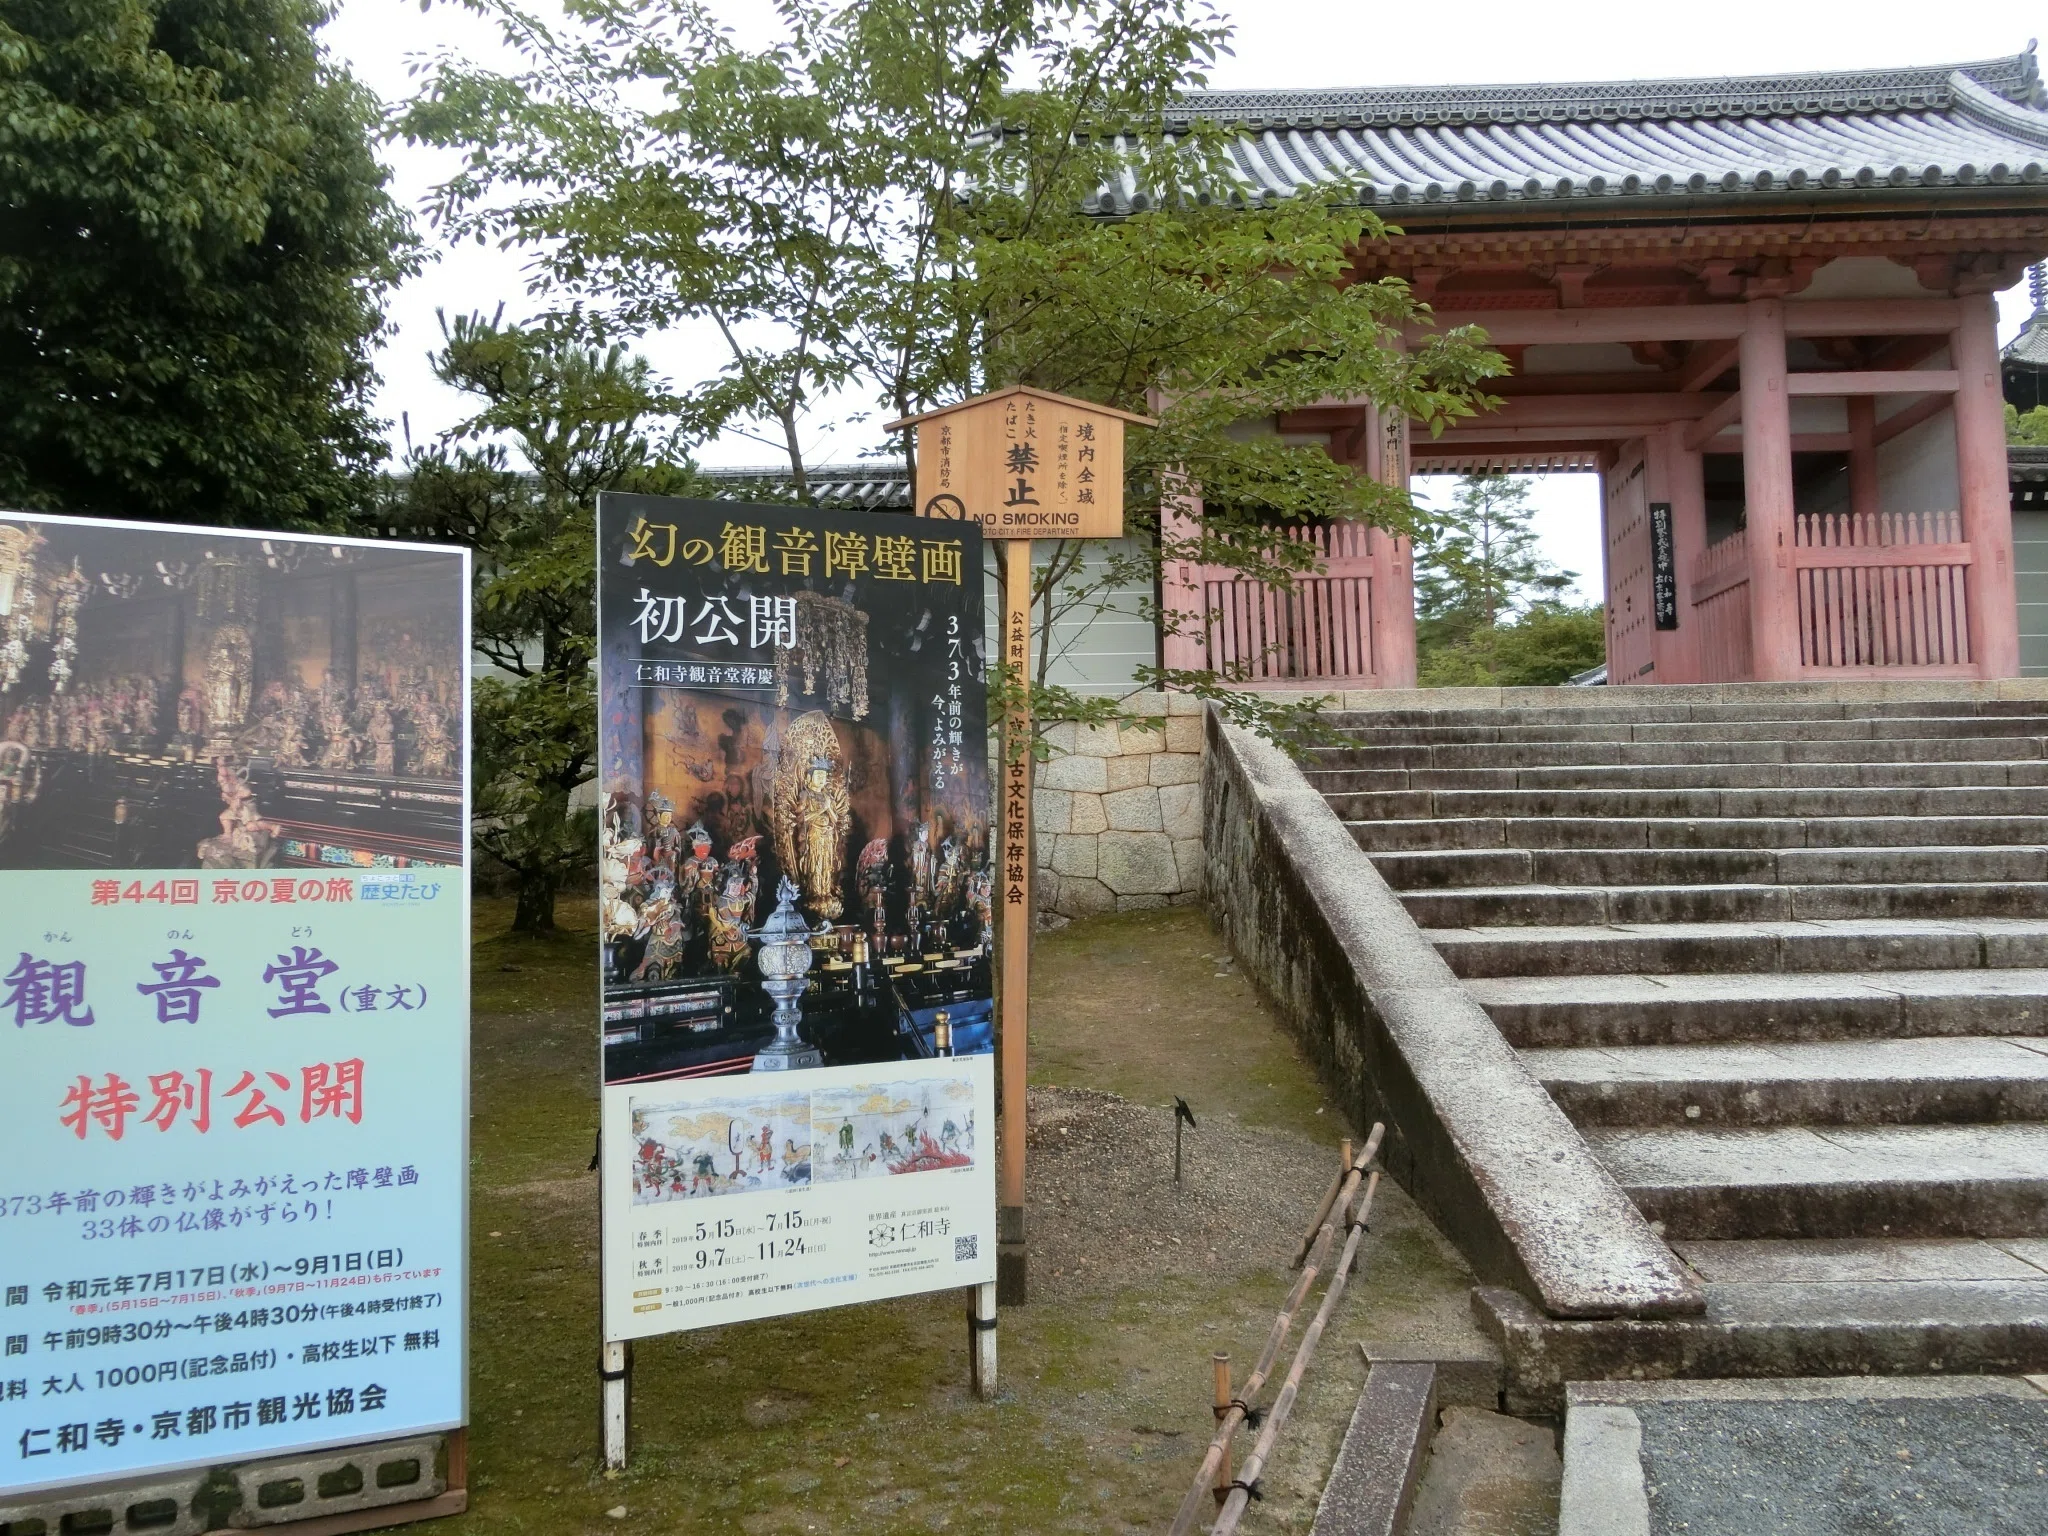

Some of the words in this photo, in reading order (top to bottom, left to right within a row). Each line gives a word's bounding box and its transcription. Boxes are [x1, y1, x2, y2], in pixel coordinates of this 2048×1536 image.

[1006, 401, 1017, 439] たばこ
[1024, 401, 1037, 439] たき火
[940, 425, 952, 488] 京都市消防局
[1003, 441, 1040, 507] 禁止
[1075, 422, 1095, 505] 境内全域
[973, 513, 996, 525] NO
[1003, 513, 1079, 525] SMOKING
[628, 517, 963, 586] 幻の観音障壁画
[629, 587, 798, 651] 初公開
[635, 663, 774, 686] 仁和寺観音堂落慶
[945, 615, 964, 776] 373年前の輝きが
[930, 694, 947, 789] 今、よみがえる
[91, 879, 199, 906] 第44回
[211, 876, 354, 904] 京の夏の旅
[360, 882, 442, 900] 歴史たび
[43, 930, 72, 943] かん
[167, 928, 194, 941] のん
[291, 925, 314, 938] どう
[59, 1057, 366, 1141] 特別公開
[900, 1217, 951, 1241] 仁和寺
[6, 1285, 28, 1307] 間
[0, 1378, 28, 1401] 料
[42, 1372, 84, 1396] 大人
[403, 1328, 440, 1352] 無料
[6, 1334, 28, 1356] 間
[19, 1382, 388, 1459] 仁和寺・京都市観光協会
